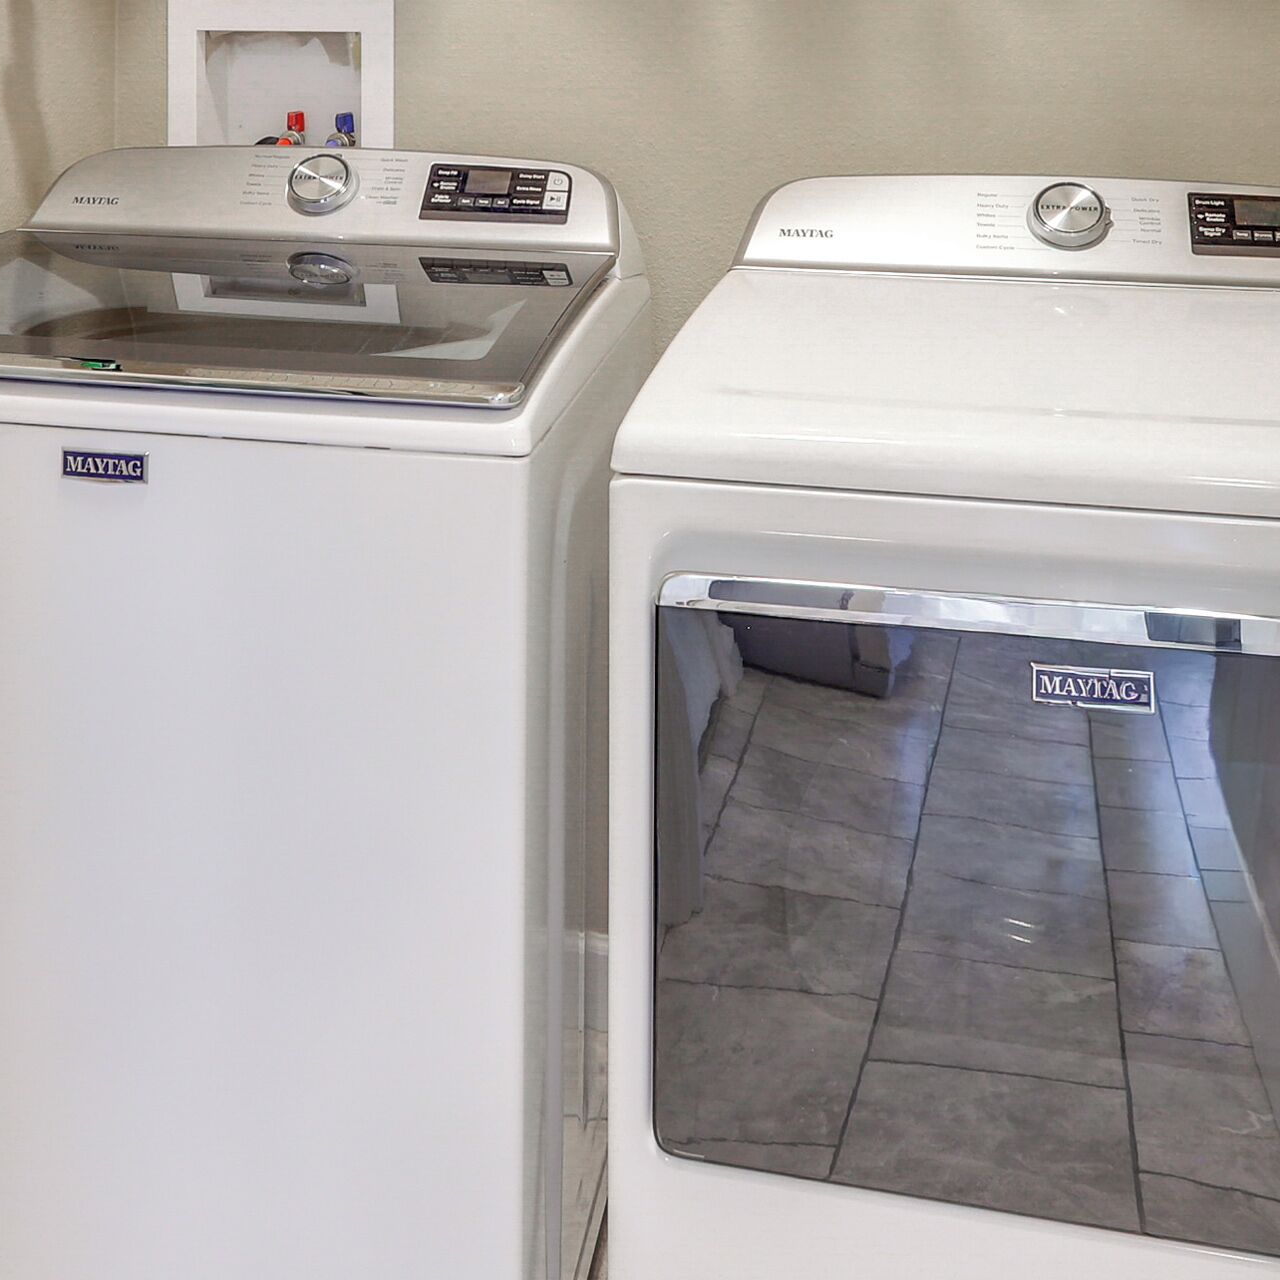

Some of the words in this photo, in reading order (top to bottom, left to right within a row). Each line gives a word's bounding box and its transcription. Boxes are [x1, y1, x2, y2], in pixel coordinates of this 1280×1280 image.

[779, 228, 834, 239] MAYTAG
[66, 456, 142, 476] MAYTAG
[1039, 674, 1139, 701] MAYTAG
